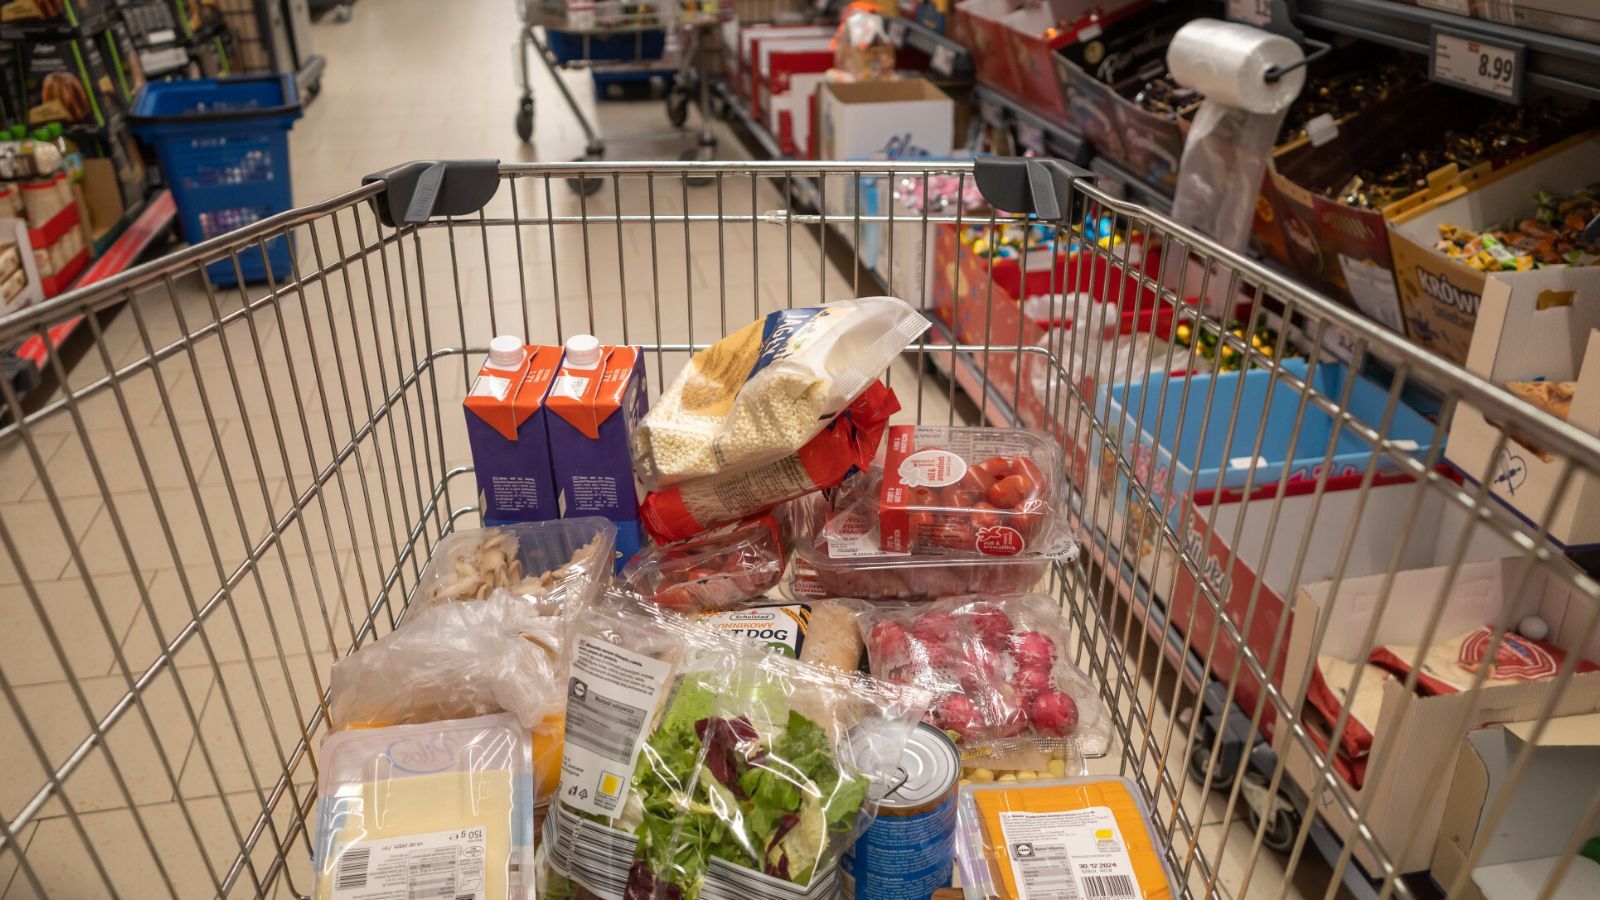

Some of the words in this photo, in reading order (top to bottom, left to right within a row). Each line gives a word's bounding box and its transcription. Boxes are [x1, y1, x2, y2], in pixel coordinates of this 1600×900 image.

[1478, 53, 1513, 82] 8.99
[746, 629, 788, 640] DOG
[460, 830, 466, 838] g
[468, 829, 482, 839] 150
